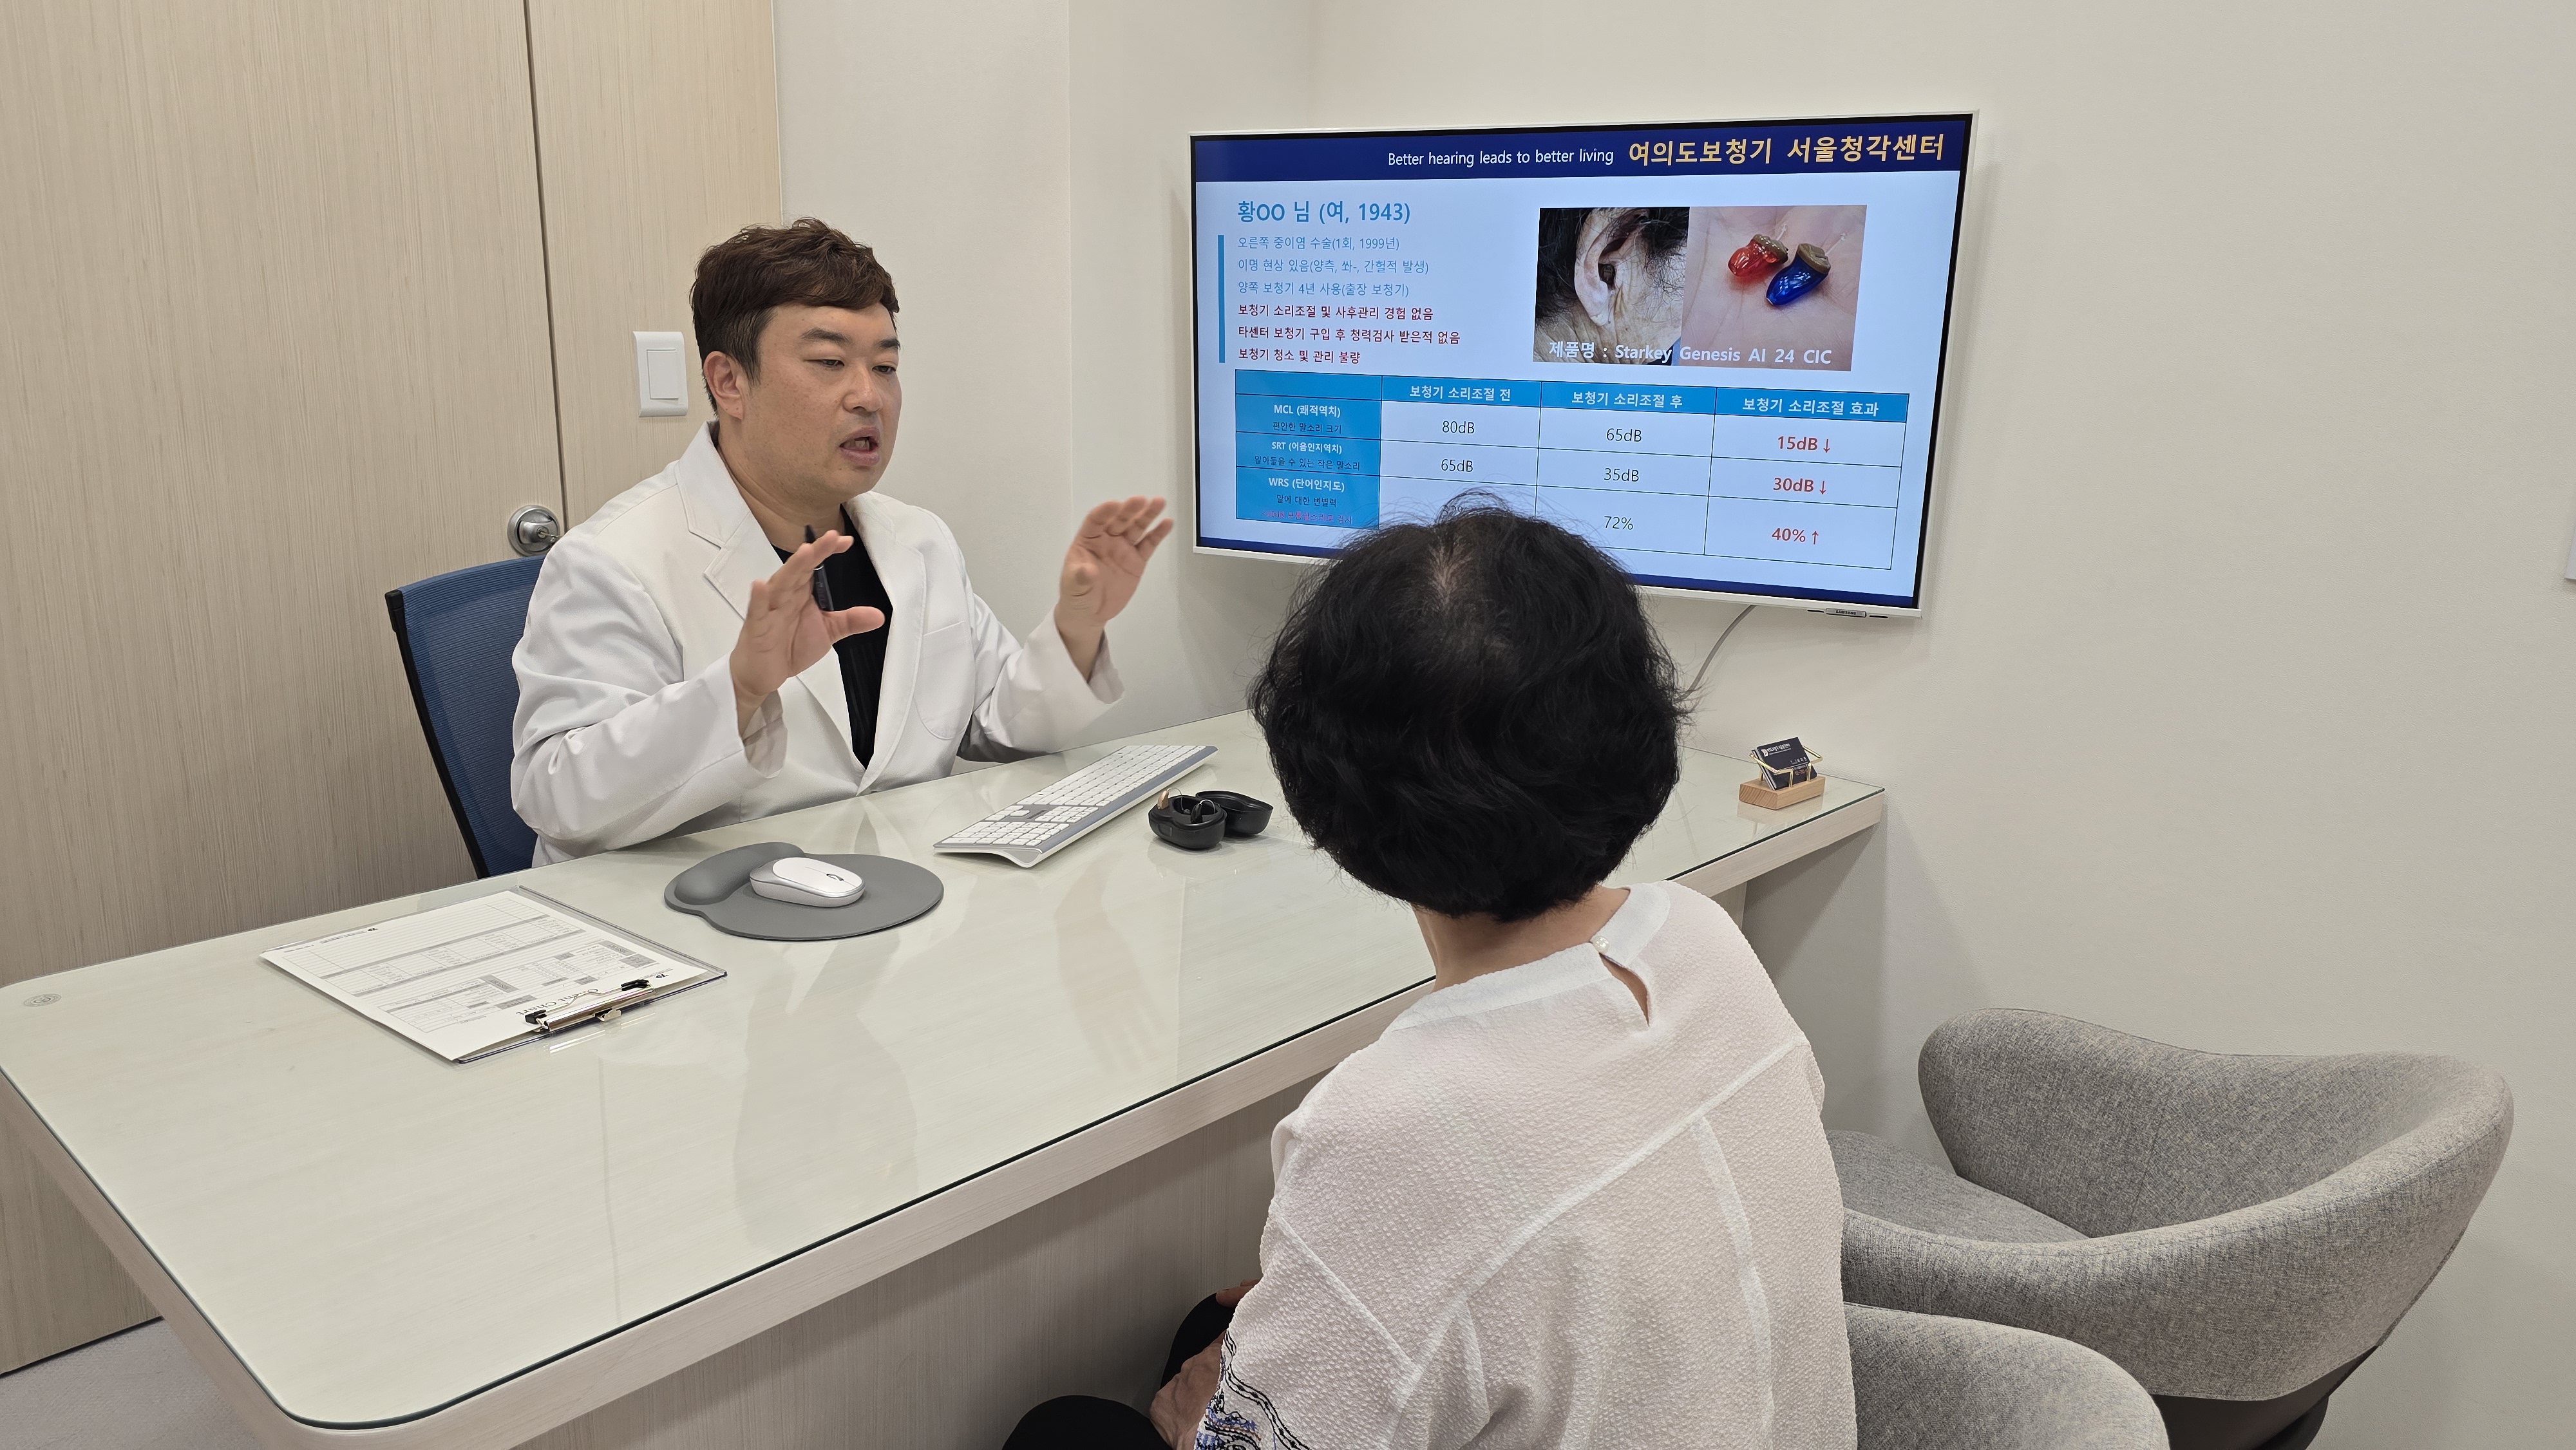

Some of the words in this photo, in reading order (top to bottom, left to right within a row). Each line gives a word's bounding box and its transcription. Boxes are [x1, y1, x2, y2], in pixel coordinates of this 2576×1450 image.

[1388, 153, 1424, 165] Better
[1428, 151, 1474, 167] hearing
[1480, 151, 1512, 164] leads
[1517, 151, 1530, 163] to
[1535, 149, 1575, 162] better
[1579, 148, 1614, 165] living
[1629, 138, 1772, 166] 여의도보청기
[1787, 133, 1944, 163] 서울청각센터
[1294, 200, 1310, 223] 님
[1319, 200, 1349, 225] (여,
[1358, 203, 1410, 225] 1943)
[1238, 237, 1269, 250] 오른쪽
[1274, 237, 1305, 250] 중이염
[1310, 237, 1355, 251] 수술(1회,
[1359, 238, 1399, 251] 1999년)
[1238, 259, 1258, 272] 이명
[1263, 259, 1283, 272] 현상
[1289, 259, 1338, 274] 있음(양측,
[1364, 260, 1397, 274] 간헐적
[1403, 260, 1429, 275] 발생)
[1238, 282, 1258, 294] 양쪽
[1263, 282, 1294, 295] 보청기
[1298, 283, 1314, 295] 4년
[1320, 283, 1367, 297] 사용(출장
[1371, 284, 1409, 297] 보청기)
[1238, 305, 1269, 317] 보청기
[1273, 305, 1316, 318] 소리조절
[1321, 306, 1331, 318] 및
[1335, 306, 1379, 319] 사후관리
[1385, 306, 1406, 320] 경험
[1411, 307, 1434, 321] 없음
[1238, 326, 1269, 339] 타센터
[1274, 327, 1305, 341] 보청기
[1309, 328, 1330, 341] 구입
[1335, 328, 1346, 341] 후
[1350, 329, 1394, 343] 청력검사
[1399, 330, 1432, 344] 받은적
[1437, 331, 1461, 344] 없음
[1238, 348, 1269, 361] 보청기
[1274, 349, 1294, 361] 청소
[1298, 350, 1308, 362] 및
[1312, 350, 1334, 363] 관리
[1338, 351, 1360, 364] 불량
[1549, 341, 1595, 359] 제품명
[1603, 347, 1608, 358] :
[1615, 344, 1672, 364] Starkey
[1680, 346, 1741, 362] Genesis
[1748, 348, 1765, 362] AI
[1775, 348, 1795, 363] 24
[1803, 349, 1832, 364] CIC
[1409, 385, 1443, 400] 보청기
[1448, 387, 1495, 401] 소리조절
[1500, 388, 1511, 402] 전
[1572, 391, 1609, 406] 보청기
[1614, 393, 1664, 408] 소리조절
[1670, 394, 1683, 409] 후
[1274, 404, 1294, 414] MCL
[1742, 398, 1783, 413] 보청기
[1788, 399, 1844, 415] 소리조절
[1850, 401, 1879, 417] 효과
[1299, 422, 1322, 433] 말소리
[1326, 424, 1341, 434] 크기
[1442, 420, 1475, 435] 80dB
[1606, 428, 1642, 443] 65dB
[1271, 441, 1286, 450] SRT
[1777, 436, 1818, 451] 15dB
[1289, 458, 1296, 467] 수
[1299, 458, 1314, 468] 있는
[1318, 459, 1334, 469] 작은
[1336, 460, 1360, 471] 말소리
[1441, 458, 1473, 473] 65dB
[1604, 467, 1640, 482] 35dB
[1268, 477, 1289, 487] WRS
[1292, 478, 1345, 493] (단어인지도)
[1773, 476, 1814, 493] 30dB
[1276, 494, 1291, 504] 말에
[1295, 496, 1310, 505] 대한
[1604, 516, 1634, 531] 72%
[1772, 527, 1806, 543] 40%
